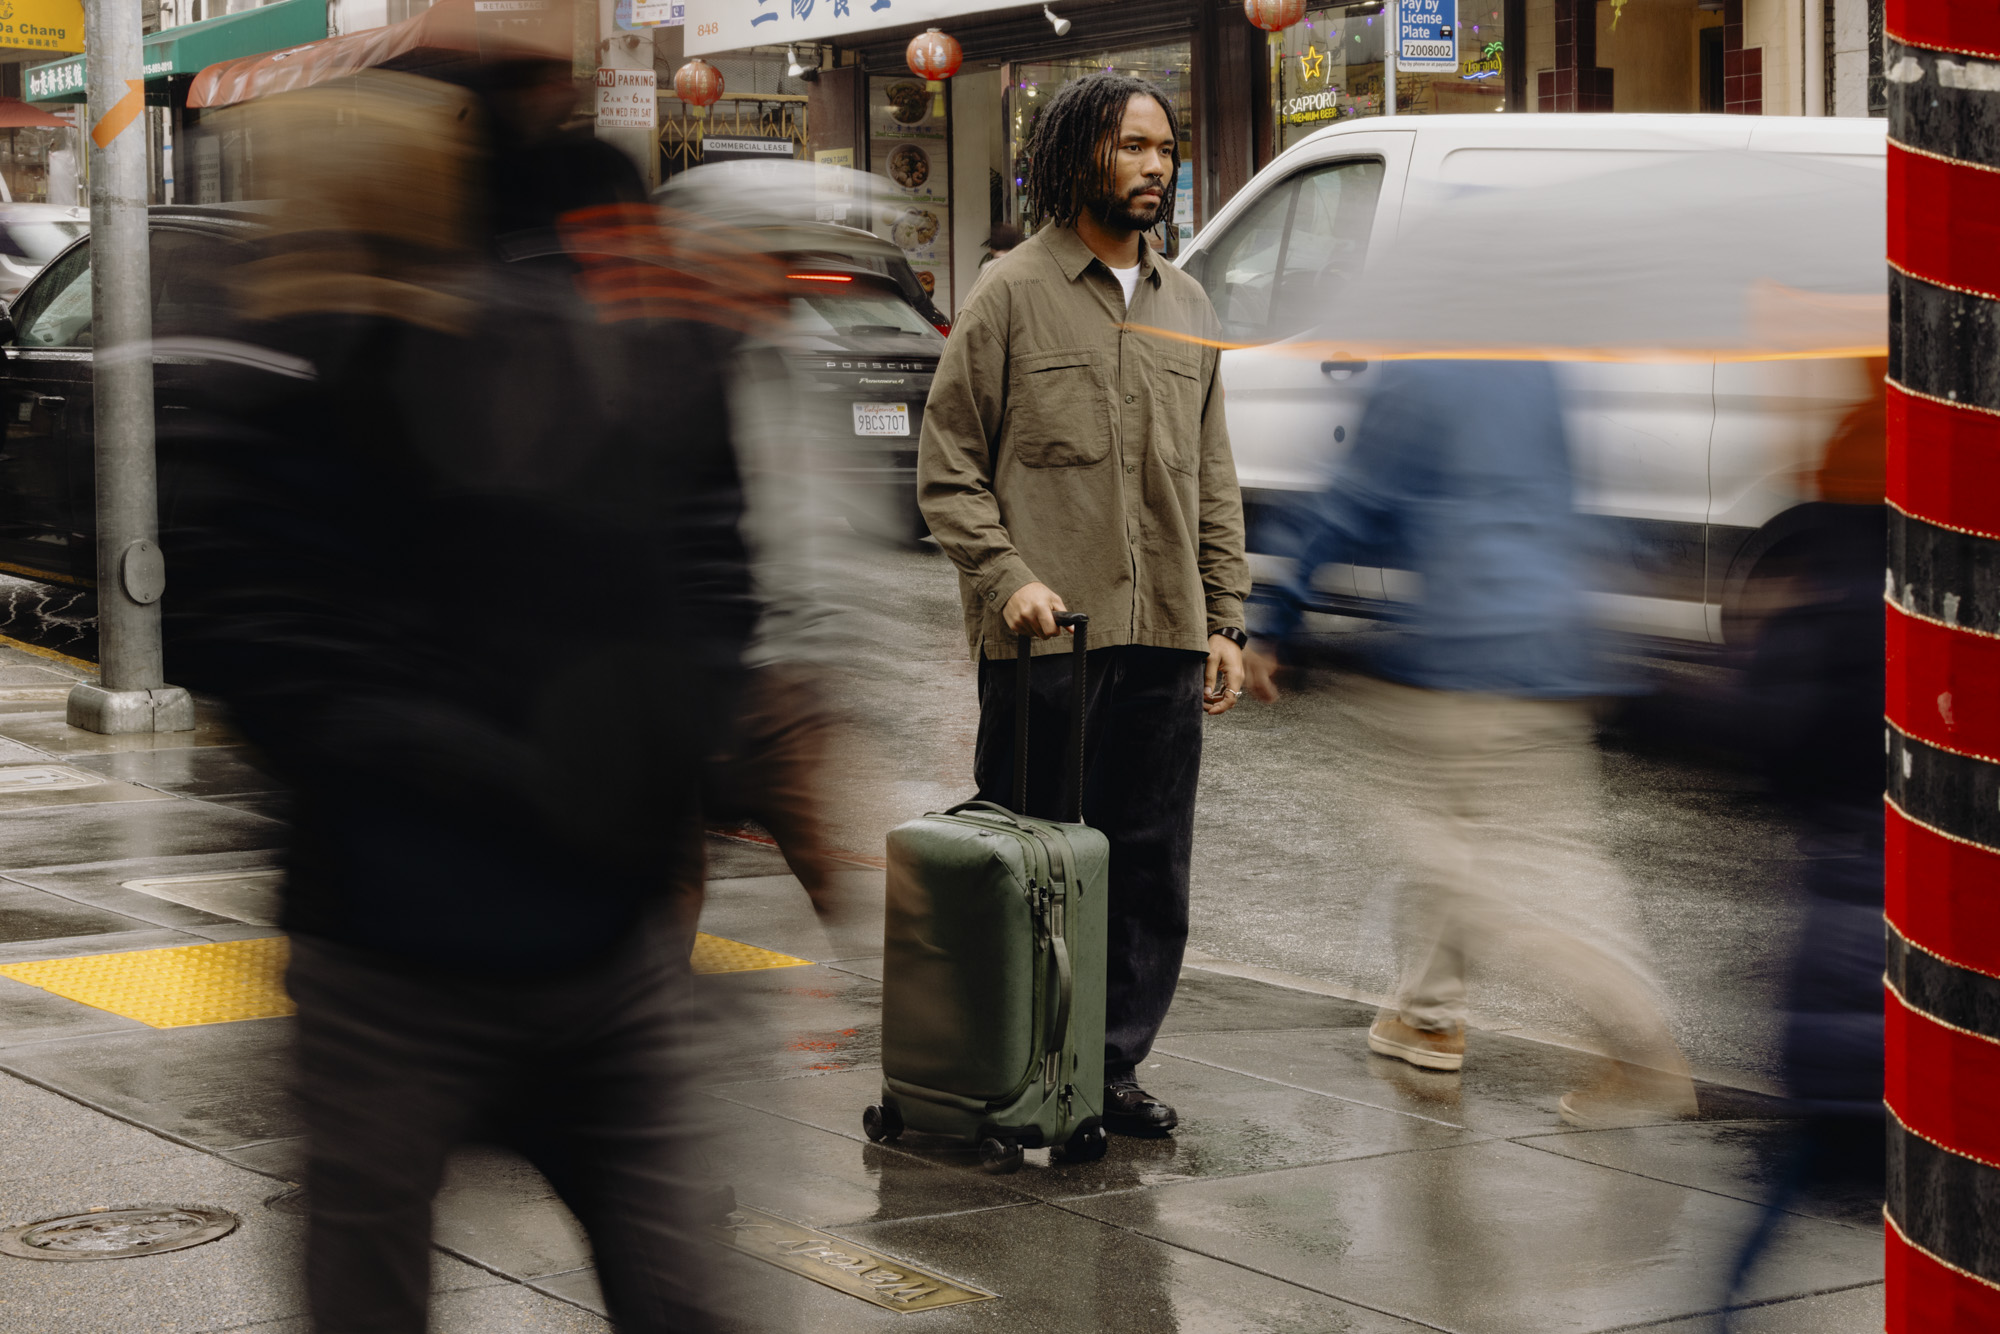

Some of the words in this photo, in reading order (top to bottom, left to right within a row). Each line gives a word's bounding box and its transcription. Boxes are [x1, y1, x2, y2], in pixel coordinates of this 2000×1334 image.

[1402, 0, 1422, 13] Pay
[1425, 0, 1439, 13] by
[1402, 10, 1443, 24] License
[20, 23, 66, 39] Chang
[697, 22, 719, 37] 848
[1402, 25, 1430, 38] Plate
[1404, 44, 1451, 57] 72008002
[1462, 59, 1499, 76] Corona
[599, 71, 615, 86] NO
[618, 75, 654, 87] PARKING
[603, 91, 610, 103] 2
[632, 92, 639, 104] 6
[1289, 91, 1337, 115] SAPPORO
[600, 107, 614, 117] MON
[616, 108, 628, 117] WED
[630, 108, 640, 117] FRI
[641, 108, 652, 118] SAT
[1289, 110, 1320, 123] PREMIUM
[1320, 107, 1337, 119] BEER
[623, 119, 651, 127] CLEANING
[709, 141, 762, 151] COMMERCIAL
[763, 143, 788, 152] LEASE
[837, 155, 849, 163] DAYS
[826, 361, 923, 370] PORSCHE
[864, 404, 895, 415] California
[858, 415, 905, 430] 9BCS707
[774, 1239, 939, 1303] Waverly
